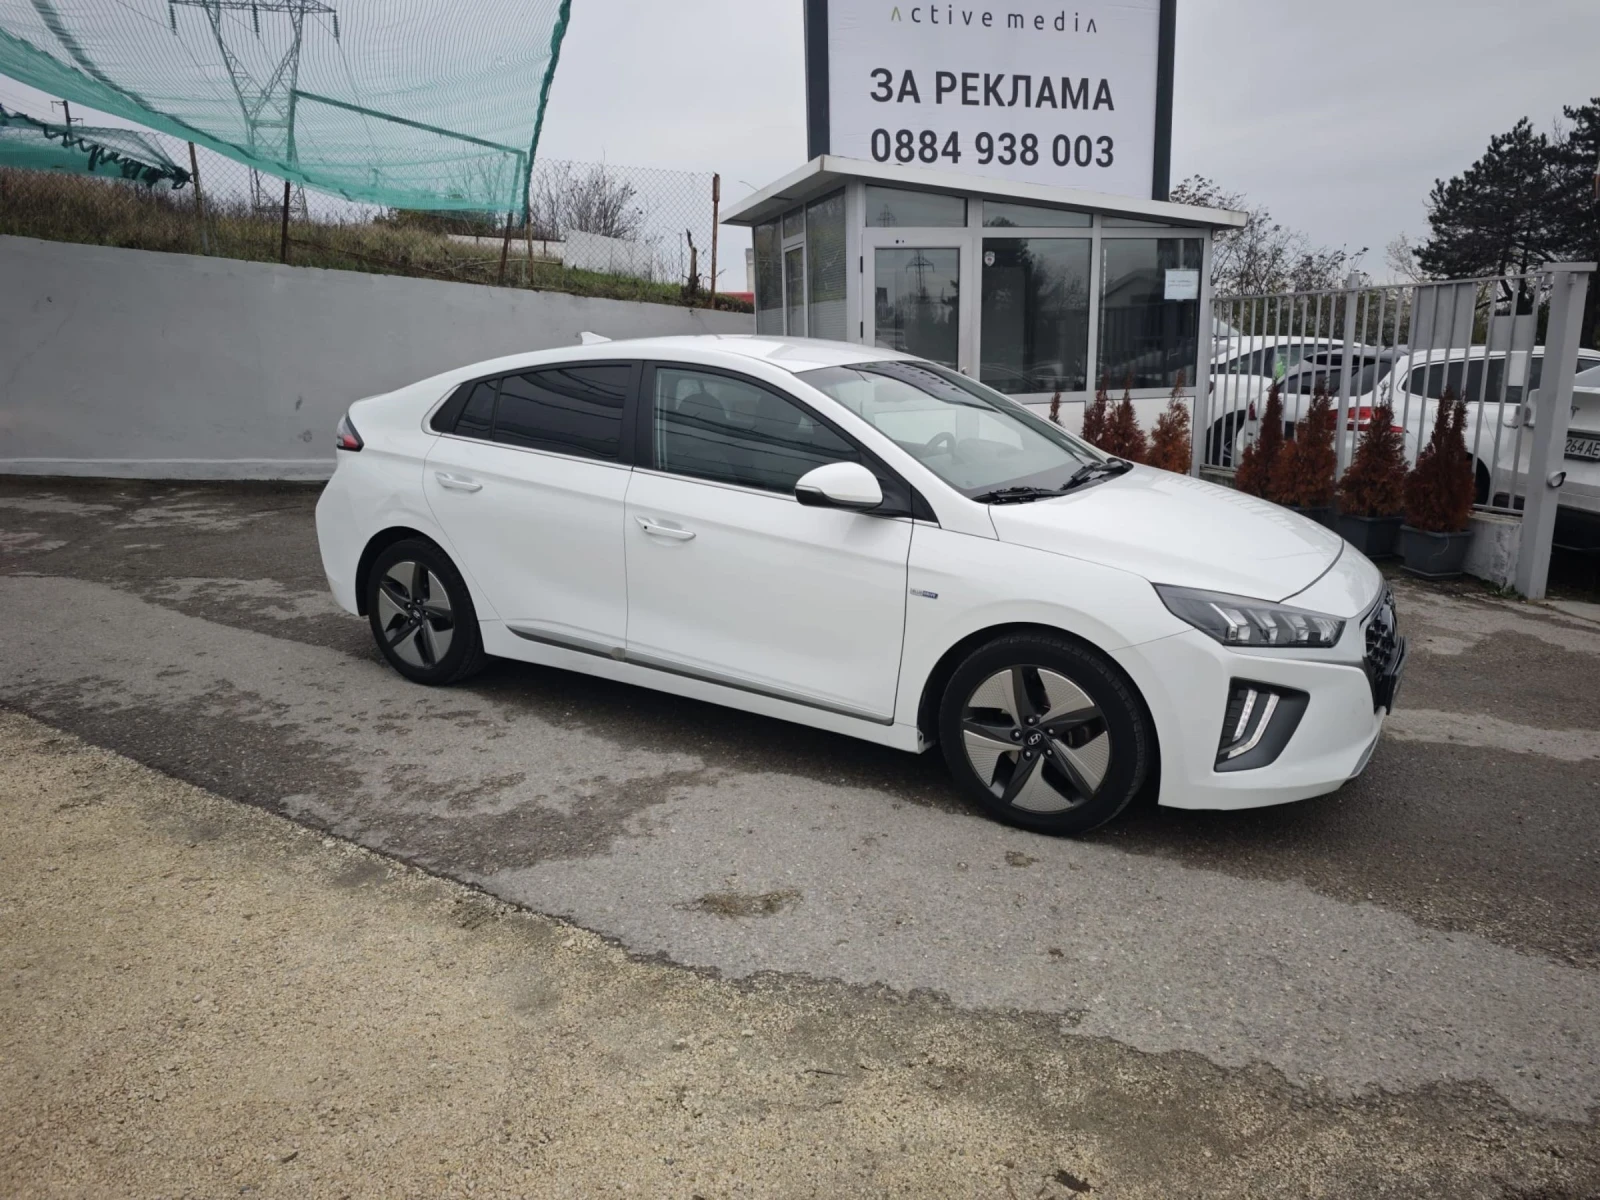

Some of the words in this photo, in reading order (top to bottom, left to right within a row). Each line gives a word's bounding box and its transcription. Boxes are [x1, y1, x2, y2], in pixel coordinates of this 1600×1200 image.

[870, 67, 921, 104] ЗА
[935, 71, 1115, 111] РЕКЛАМА
[871, 128, 962, 164] 0884
[974, 131, 1039, 166] 938
[1052, 134, 1114, 168] 003
